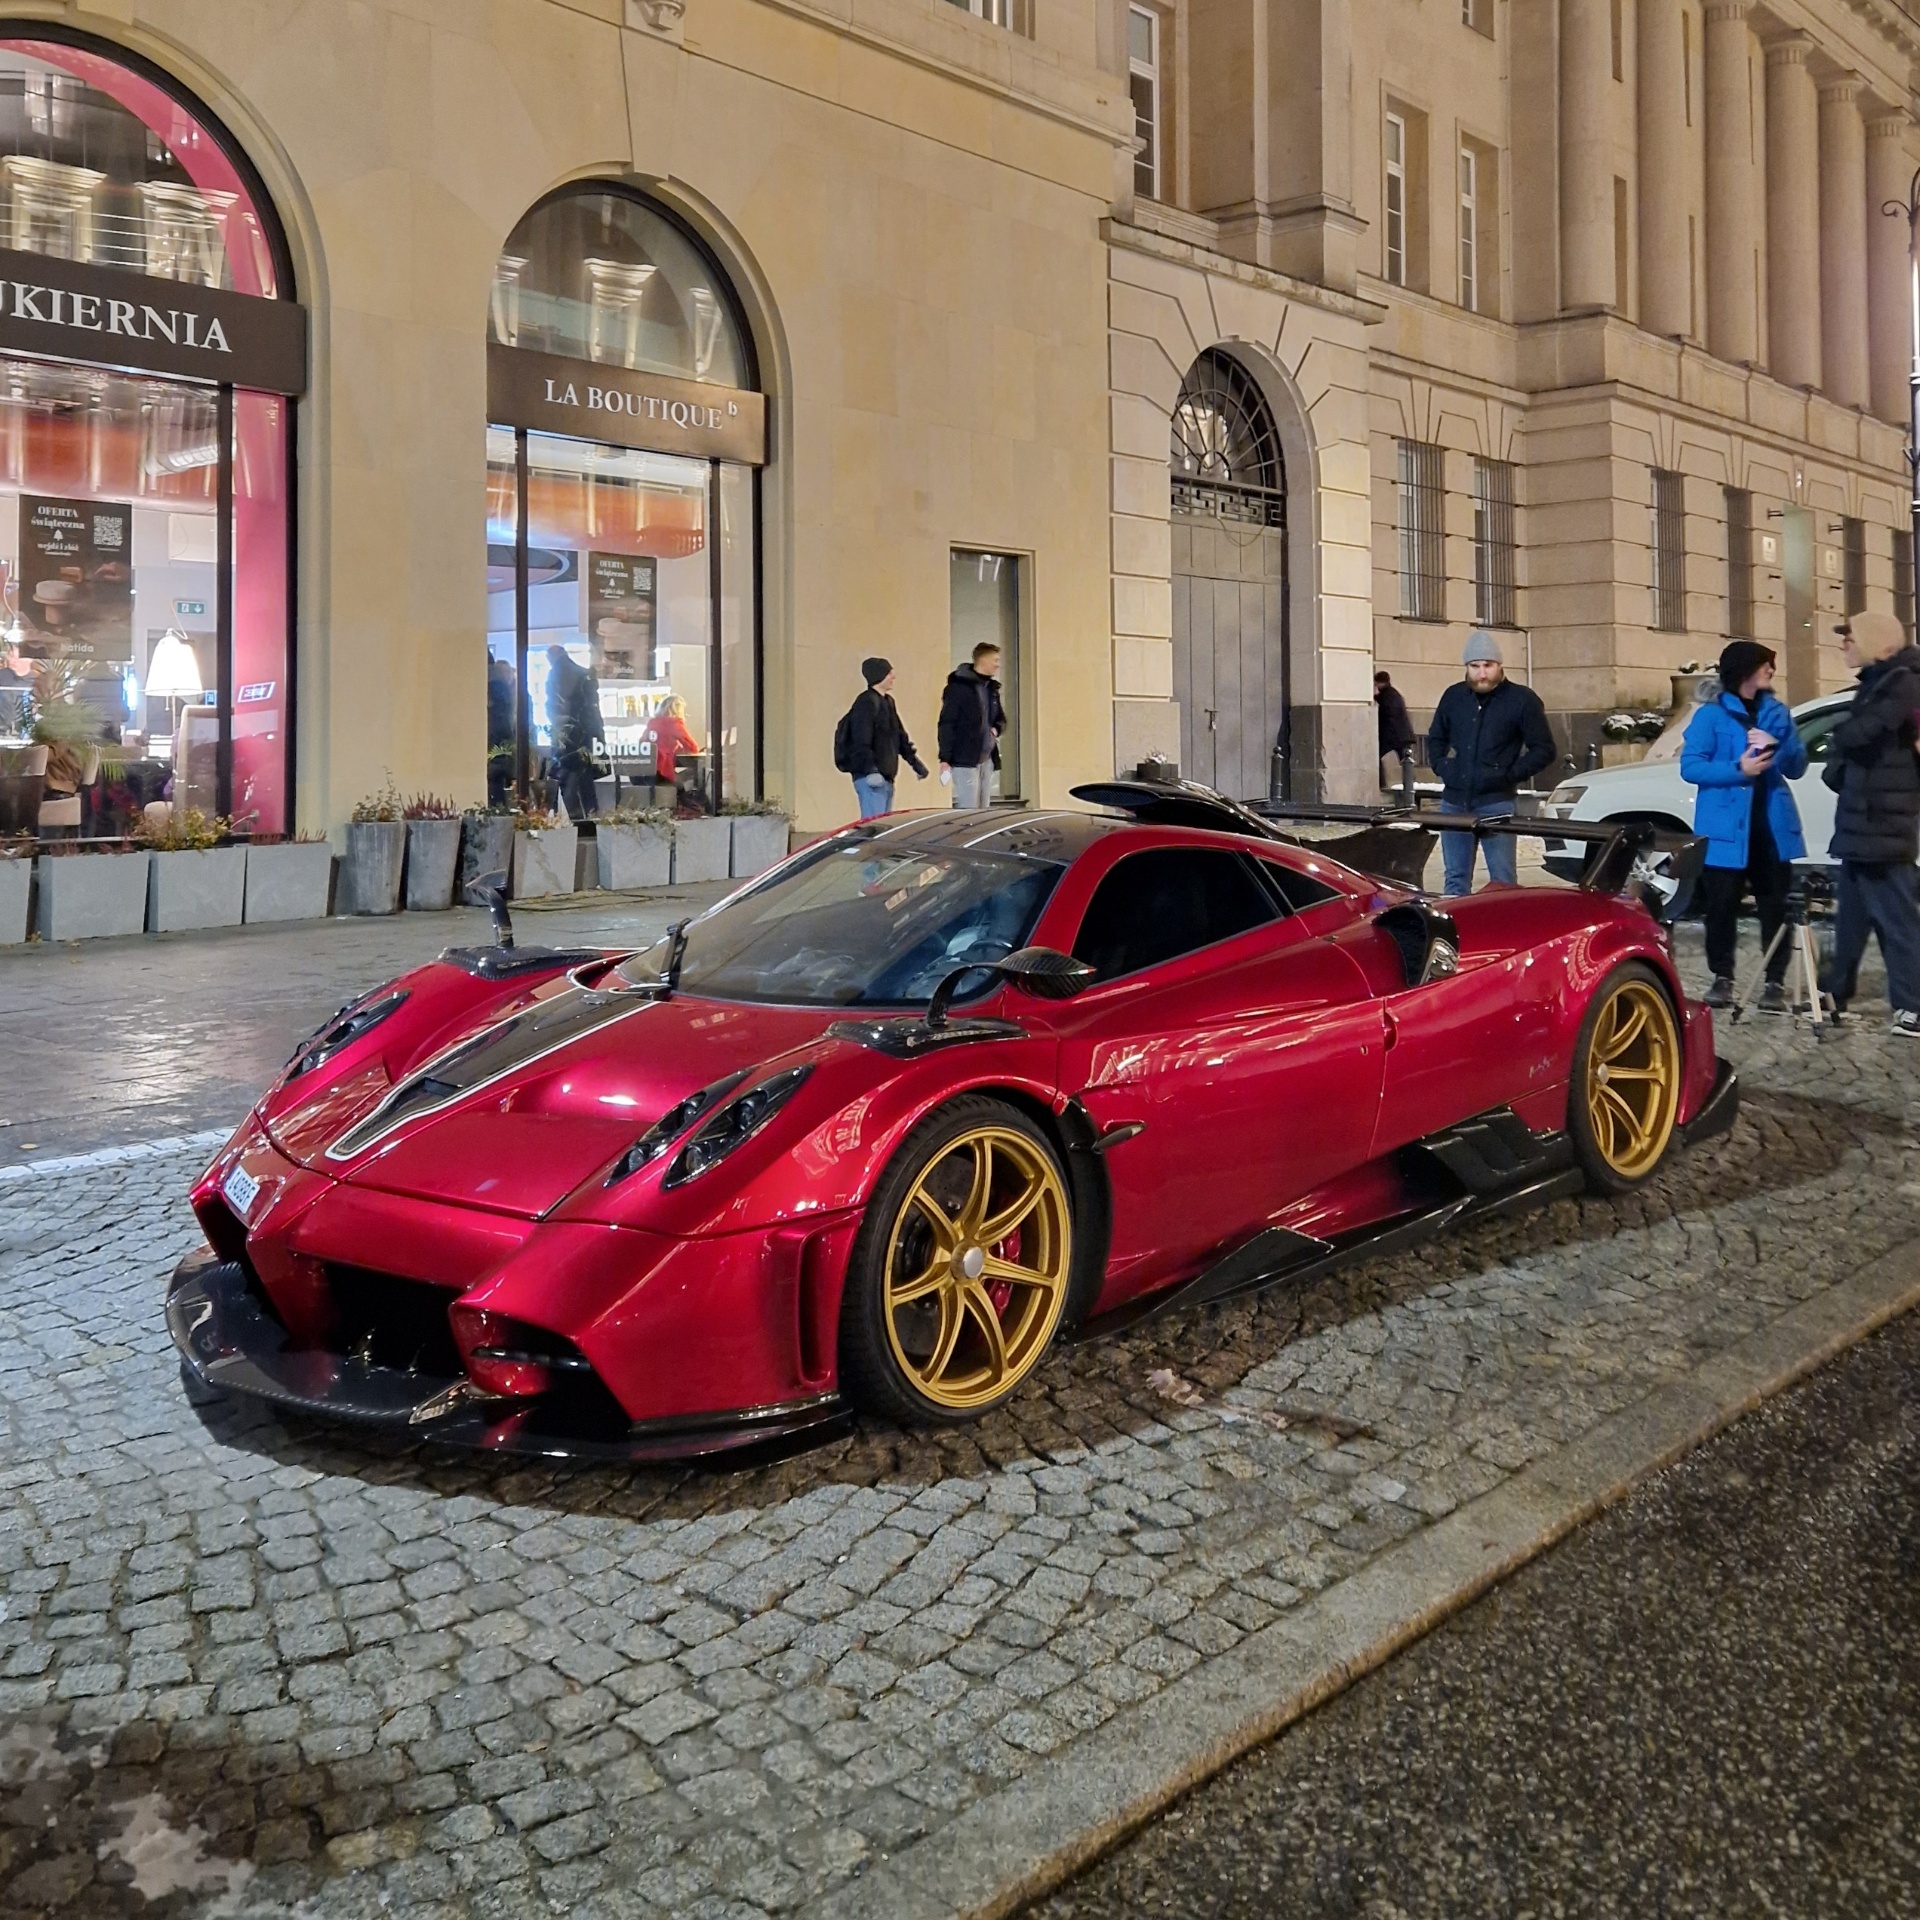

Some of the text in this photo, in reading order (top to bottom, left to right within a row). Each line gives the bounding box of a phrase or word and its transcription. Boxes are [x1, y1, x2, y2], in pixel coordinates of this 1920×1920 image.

[0, 279, 233, 353] KIERNIA
[544, 378, 581, 407] LA
[587, 386, 723, 430] BOUTIQUE
[37, 505, 79, 518] OFERTA
